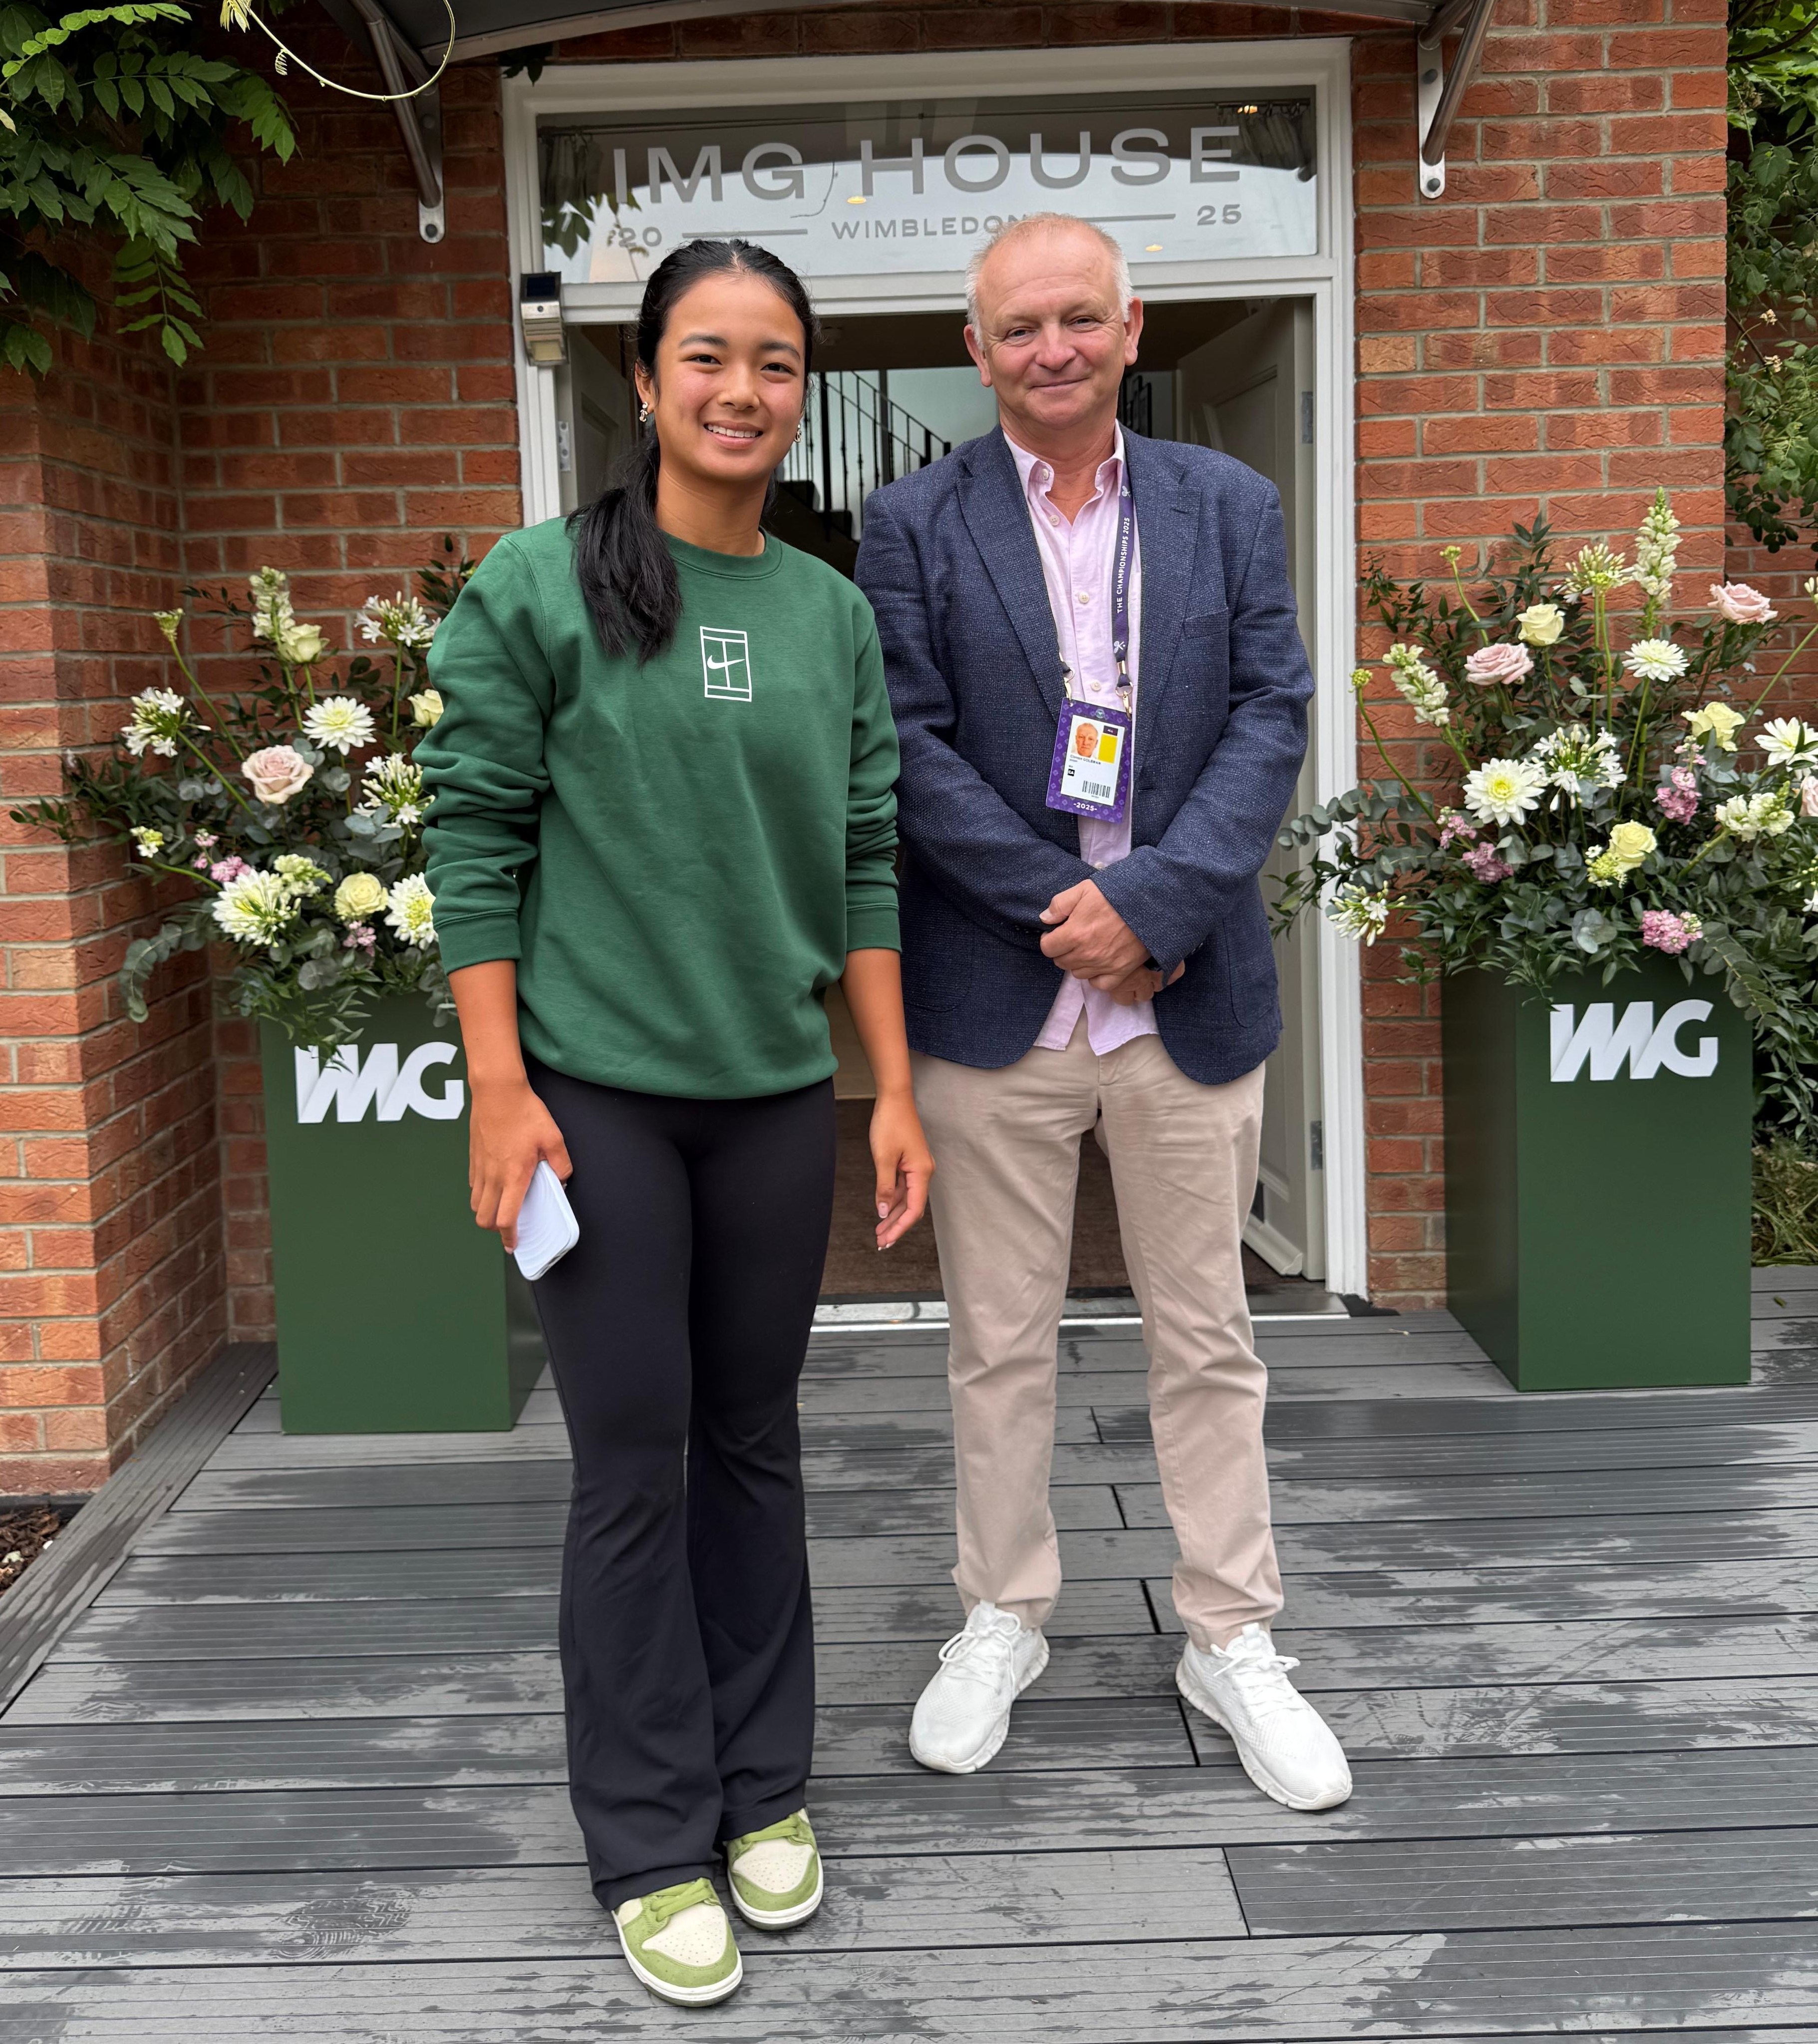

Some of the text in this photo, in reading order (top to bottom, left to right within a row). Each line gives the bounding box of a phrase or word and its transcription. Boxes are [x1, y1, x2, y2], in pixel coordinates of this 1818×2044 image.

[613, 127, 1241, 204] IMG HOUSE
[618, 226, 662, 248] 20
[1197, 205, 1242, 227] 25
[1117, 536, 1129, 594] CHAMPIONSHIPS
[1550, 999, 1719, 1082] IMG
[295, 1041, 465, 1124] IMG
